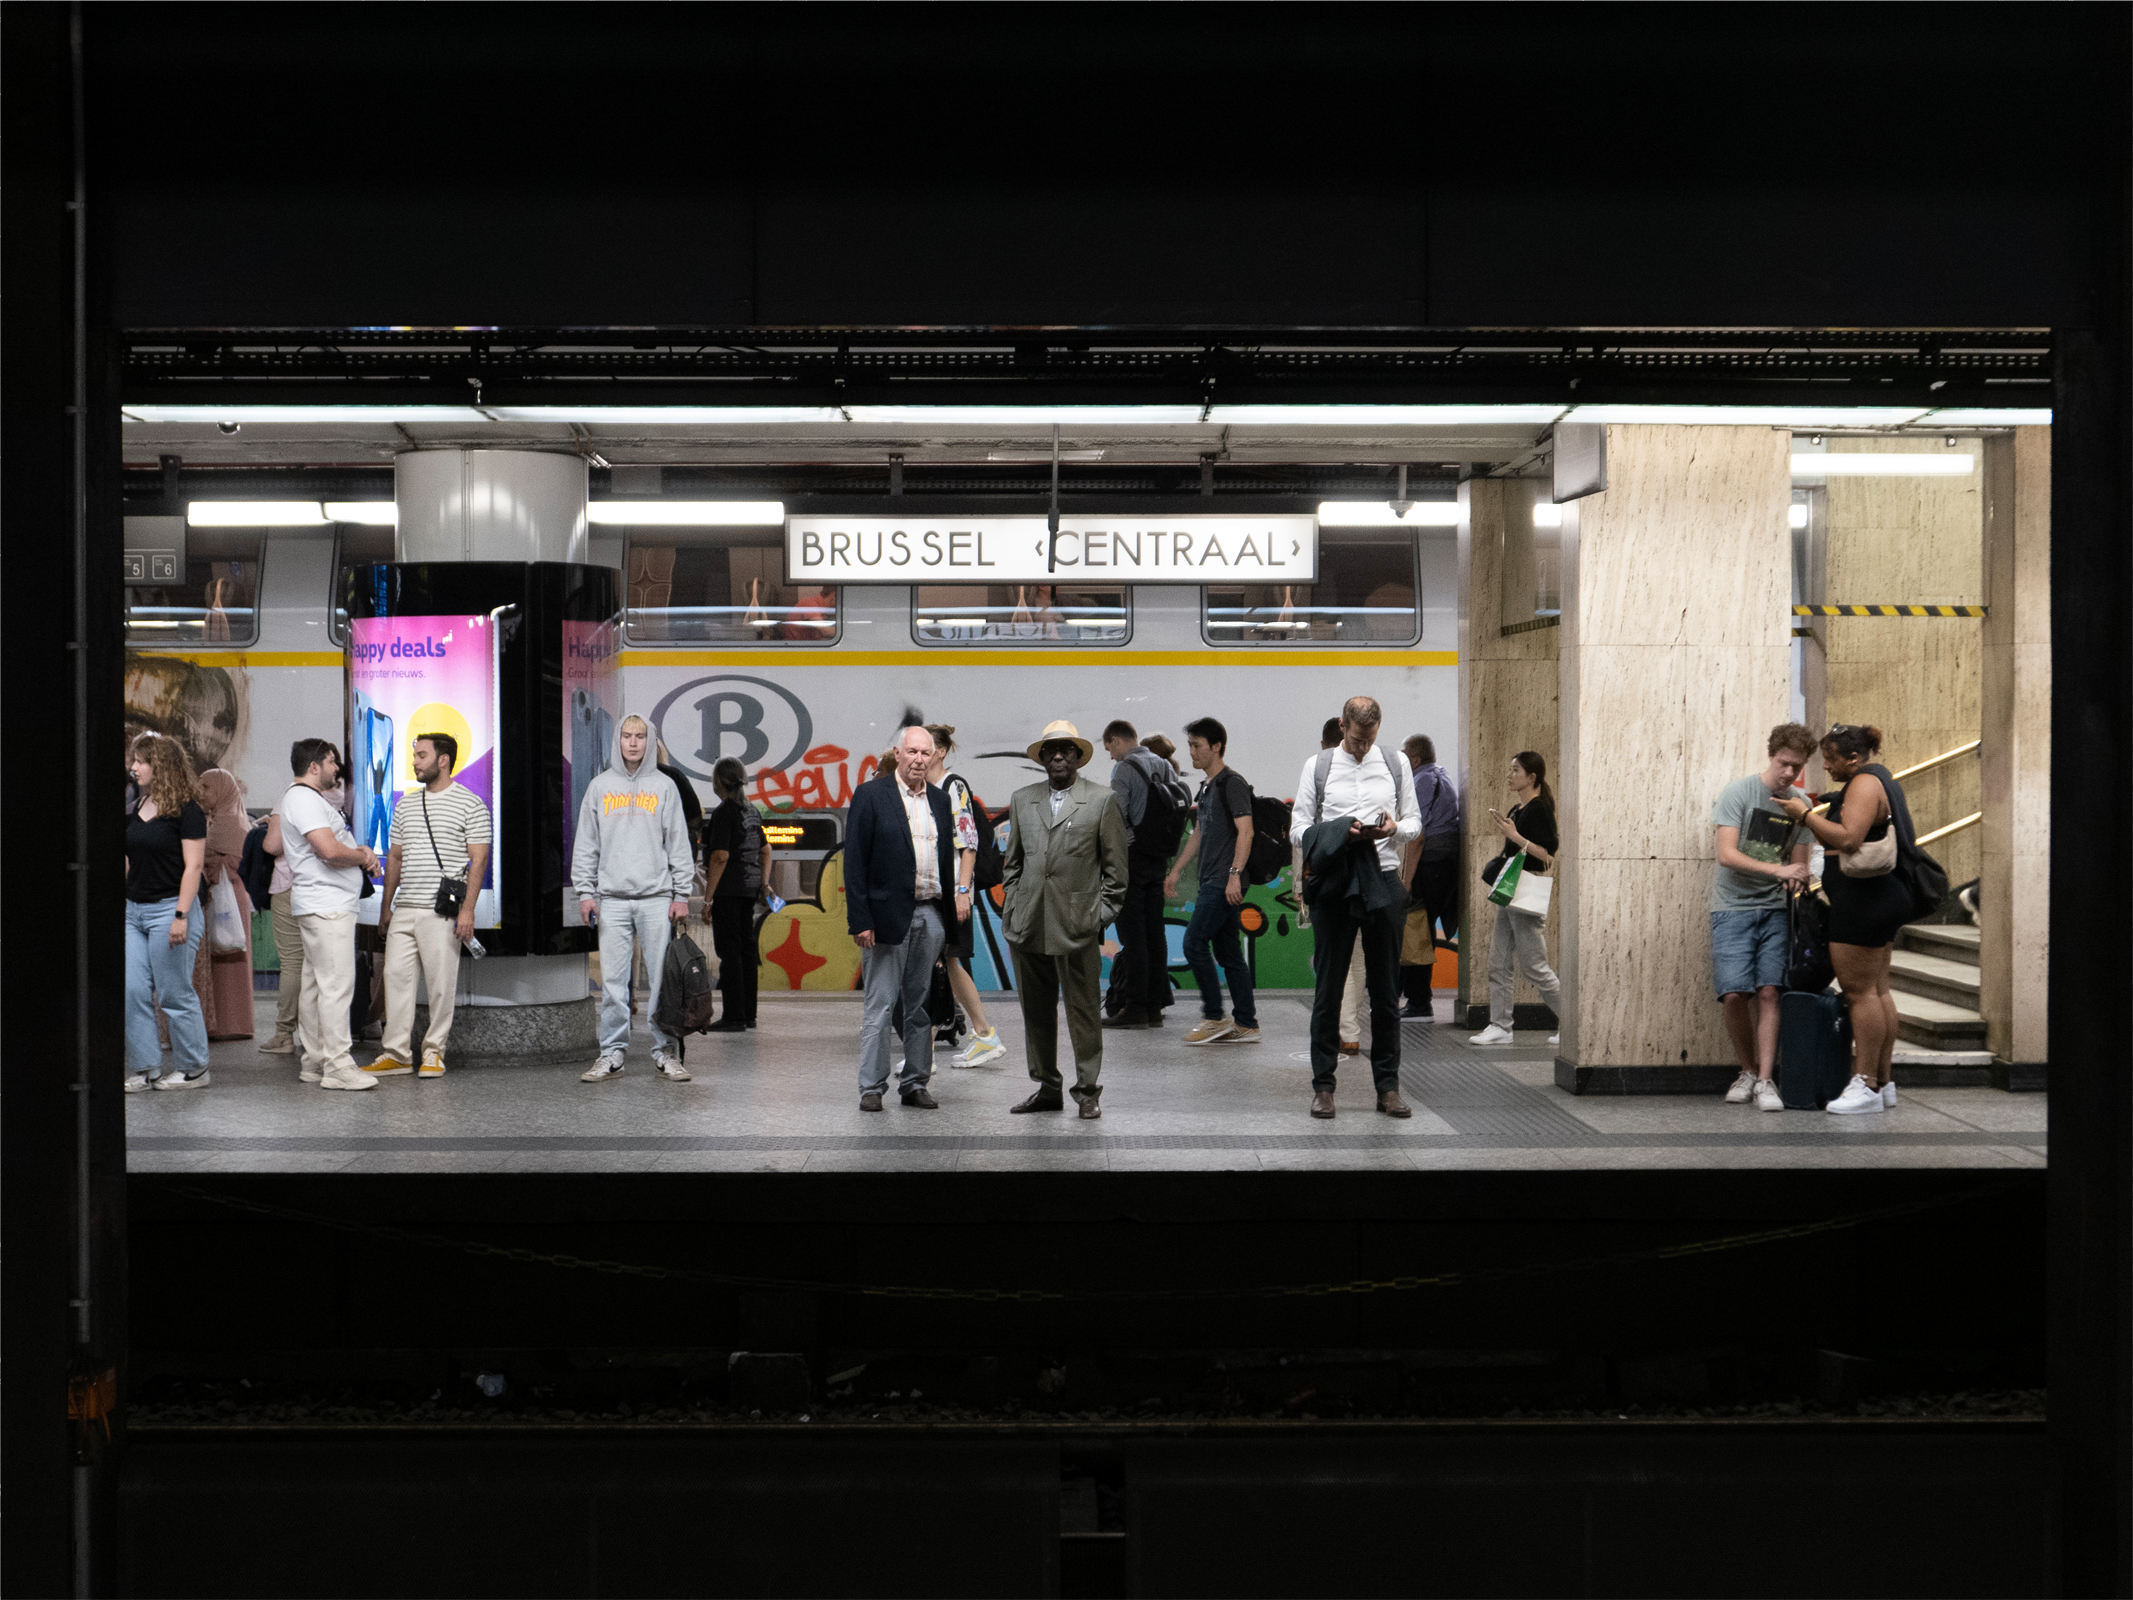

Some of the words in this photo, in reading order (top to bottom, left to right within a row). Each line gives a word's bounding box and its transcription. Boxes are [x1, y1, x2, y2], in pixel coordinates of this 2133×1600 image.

[802, 530, 996, 566] BRUSSEL
[1053, 530, 1286, 567] CENTRAAL
[132, 563, 140, 576] 5
[164, 563, 172, 576] 6
[390, 636, 446, 658] deals
[369, 669, 390, 681] groter
[392, 667, 426, 678] nieuws.
[693, 691, 770, 767] B
[761, 825, 805, 835] uillemins
[766, 834, 797, 844] lemins
